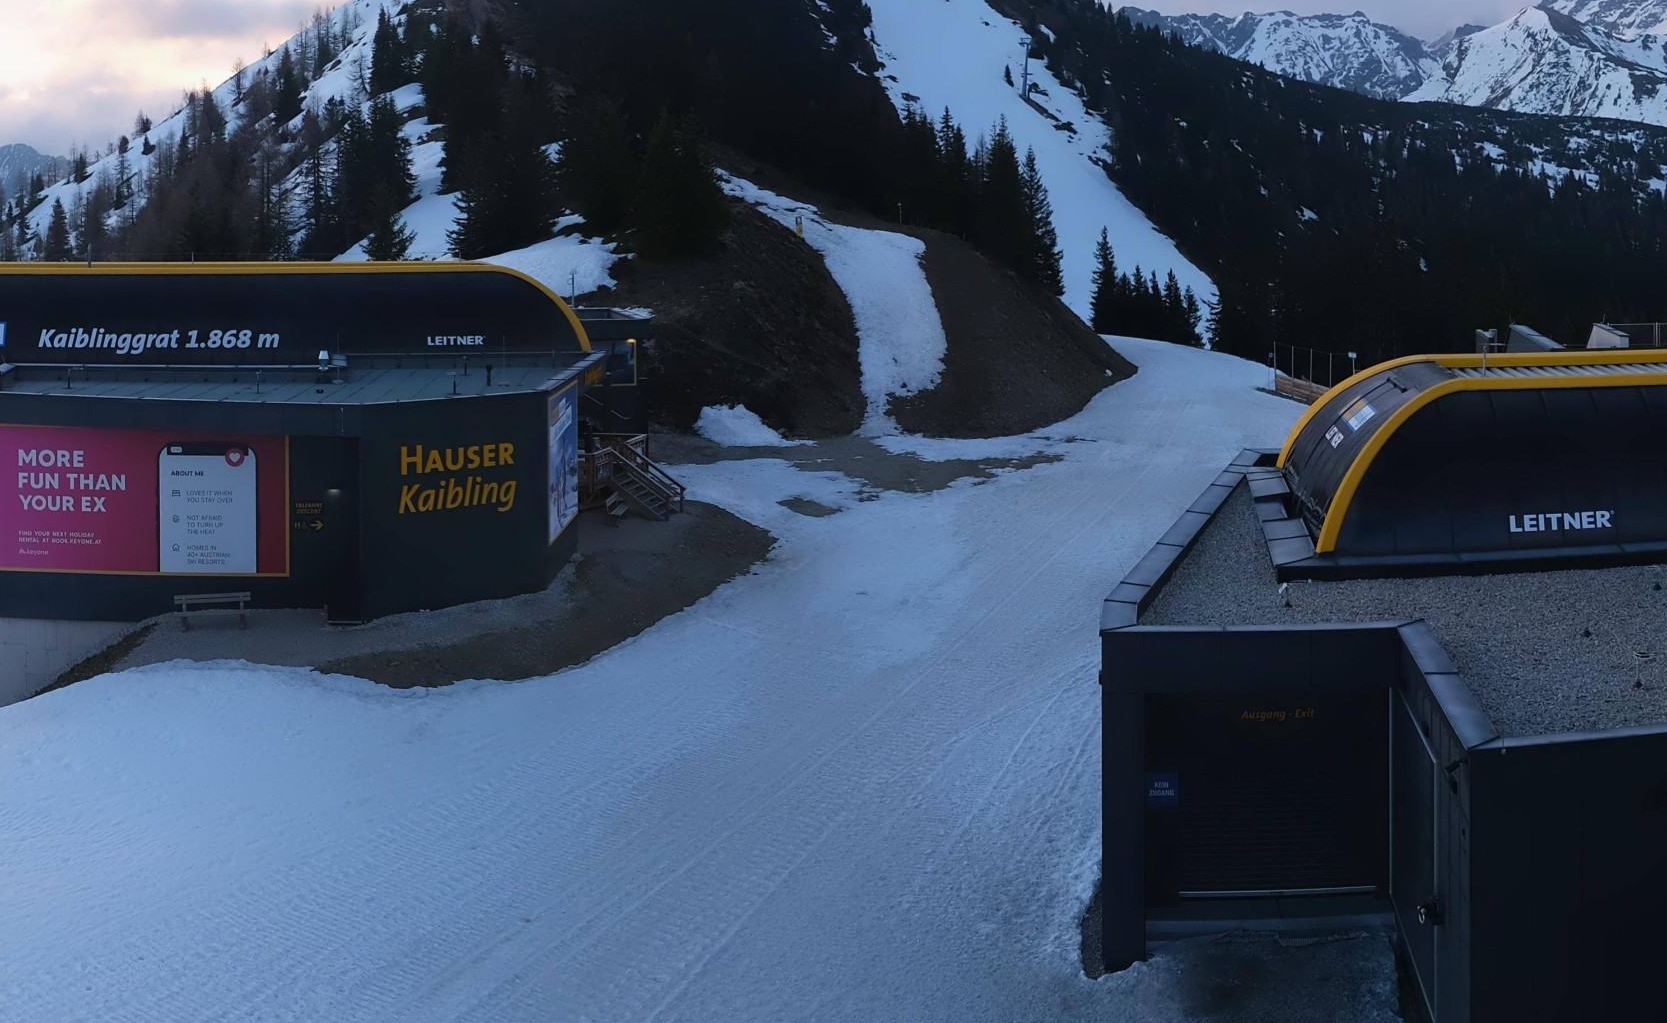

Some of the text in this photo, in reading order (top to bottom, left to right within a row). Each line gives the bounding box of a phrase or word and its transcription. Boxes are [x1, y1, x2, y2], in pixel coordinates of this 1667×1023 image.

[38, 328, 280, 355] Kaiblinggrat 1.868 m
[427, 335, 484, 346] LEITNER
[18, 449, 84, 467] MORE
[400, 442, 515, 476] HAUSER
[18, 472, 126, 491] FUN THAN
[18, 494, 107, 512] YOUR EX
[398, 476, 517, 514] Kaibling
[1509, 510, 1612, 533] LEITNER
[27, 548, 49, 556] keyone
[1240, 710, 1286, 722] Ausgang
[1295, 708, 1315, 718] Exit
